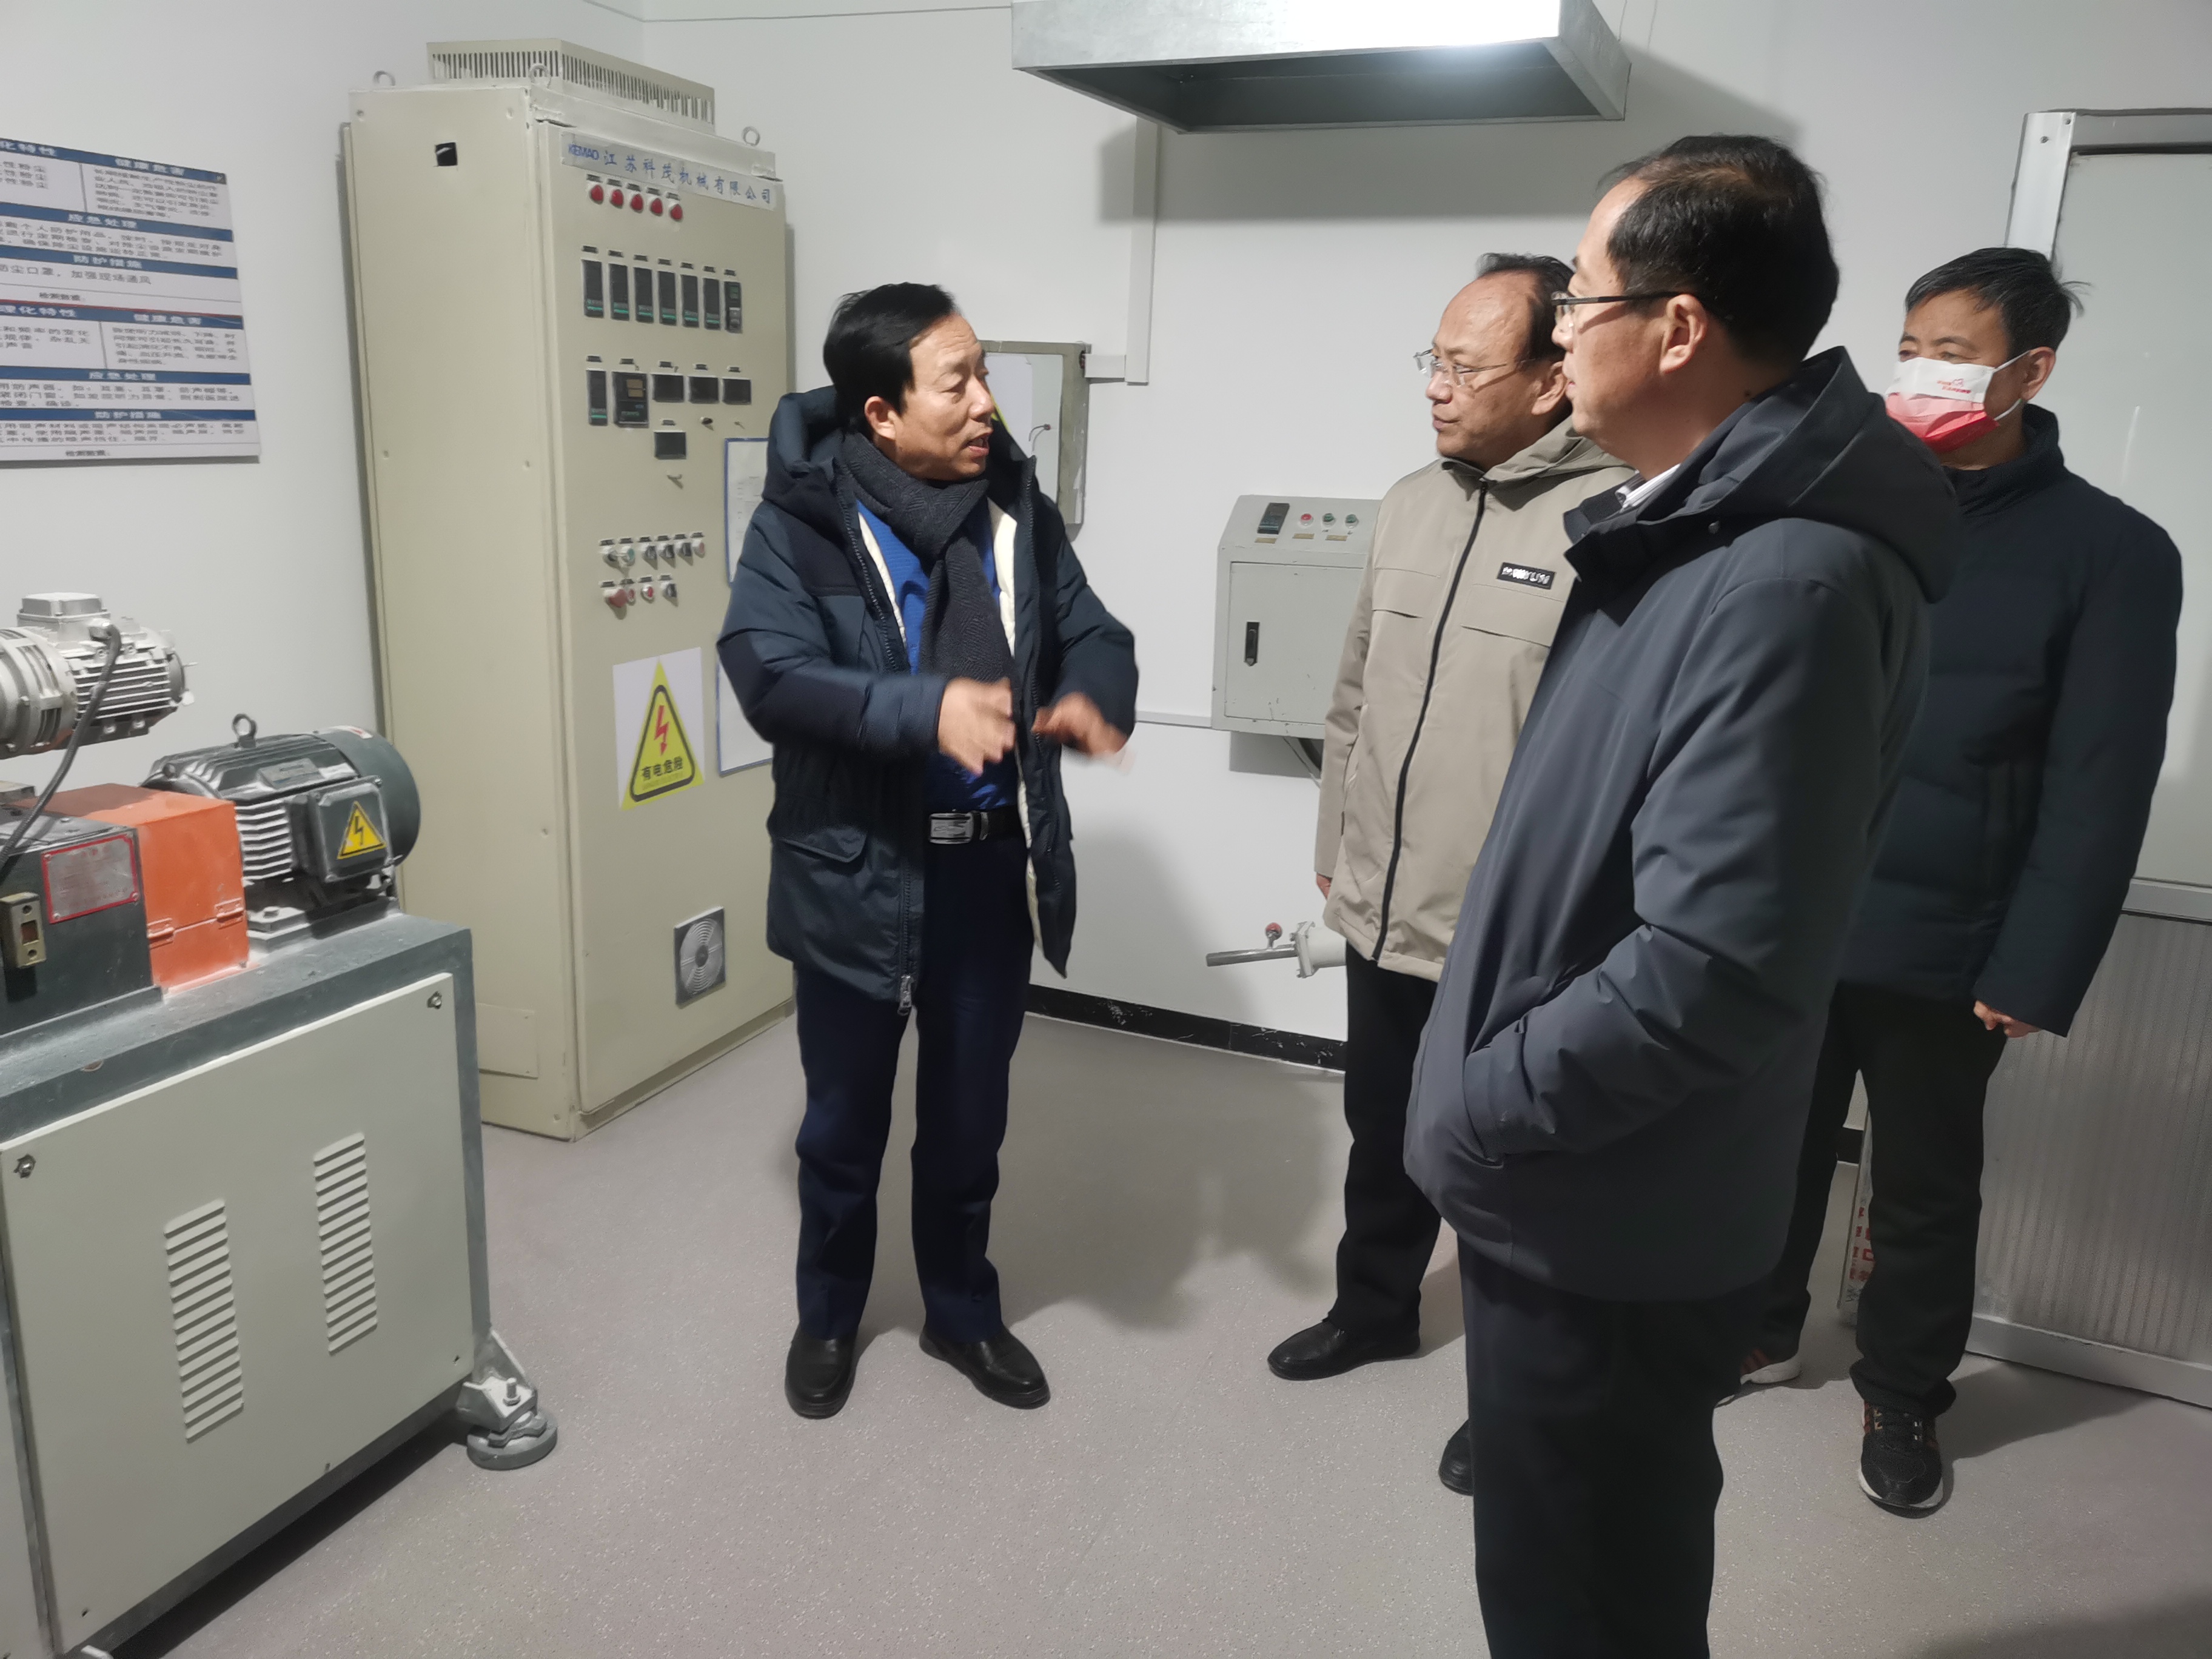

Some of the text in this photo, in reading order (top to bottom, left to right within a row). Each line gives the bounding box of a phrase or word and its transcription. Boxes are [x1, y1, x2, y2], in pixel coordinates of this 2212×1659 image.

[605, 150, 771, 204] 江苏科茂机械有限公司
